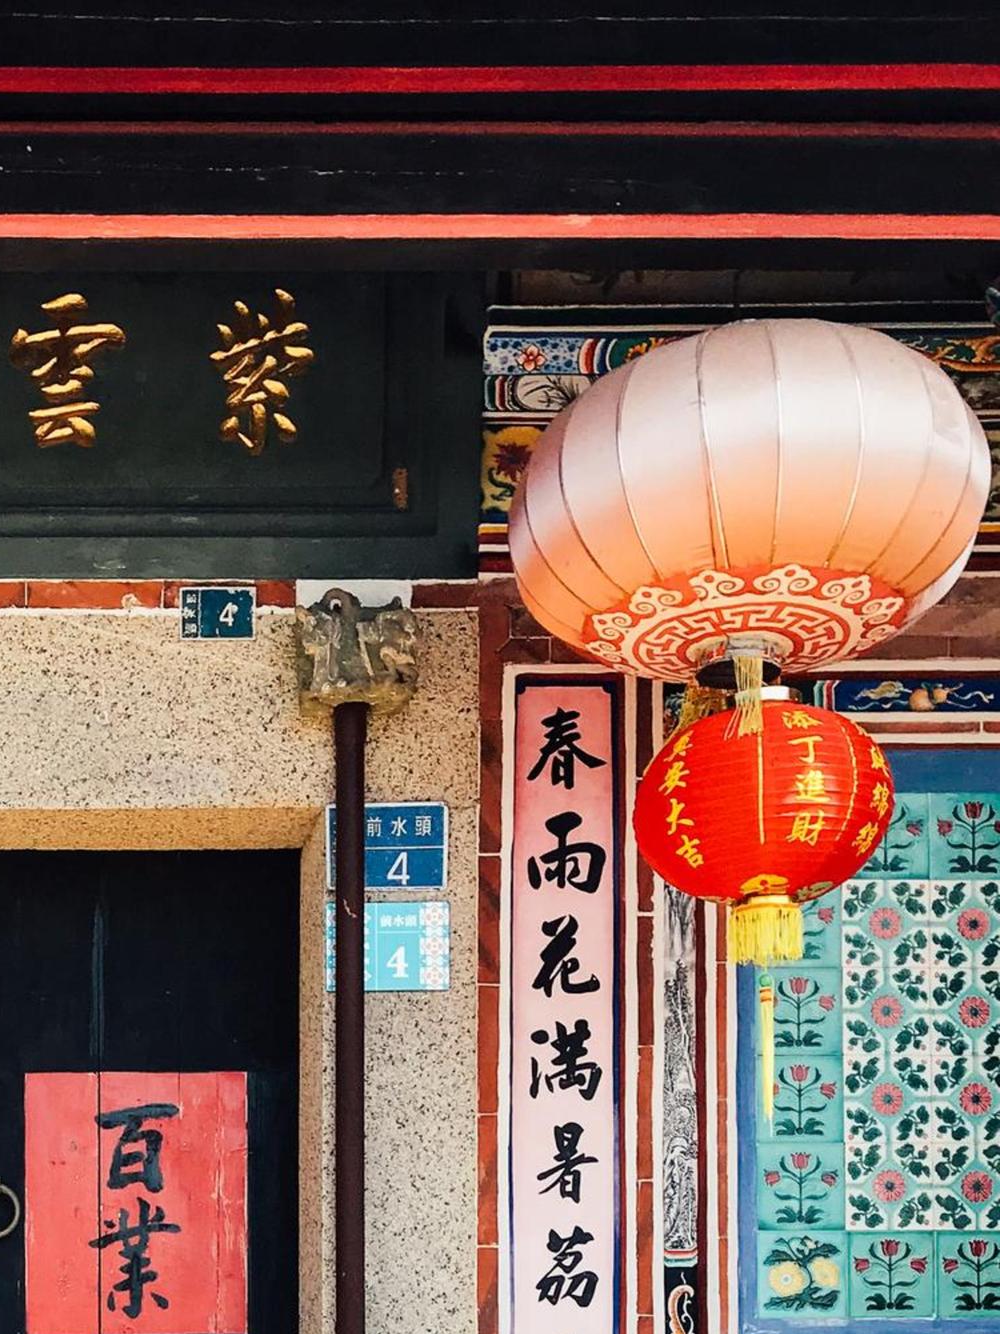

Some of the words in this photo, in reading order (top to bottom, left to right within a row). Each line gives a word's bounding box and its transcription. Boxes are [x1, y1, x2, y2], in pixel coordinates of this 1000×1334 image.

[219, 601, 236, 627] 4
[781, 709, 832, 847] 添丁進財
[366, 815, 432, 837] 前水頭
[386, 851, 410, 885] 4
[386, 946, 409, 979] 4
[88, 1102, 182, 1319] 百業
